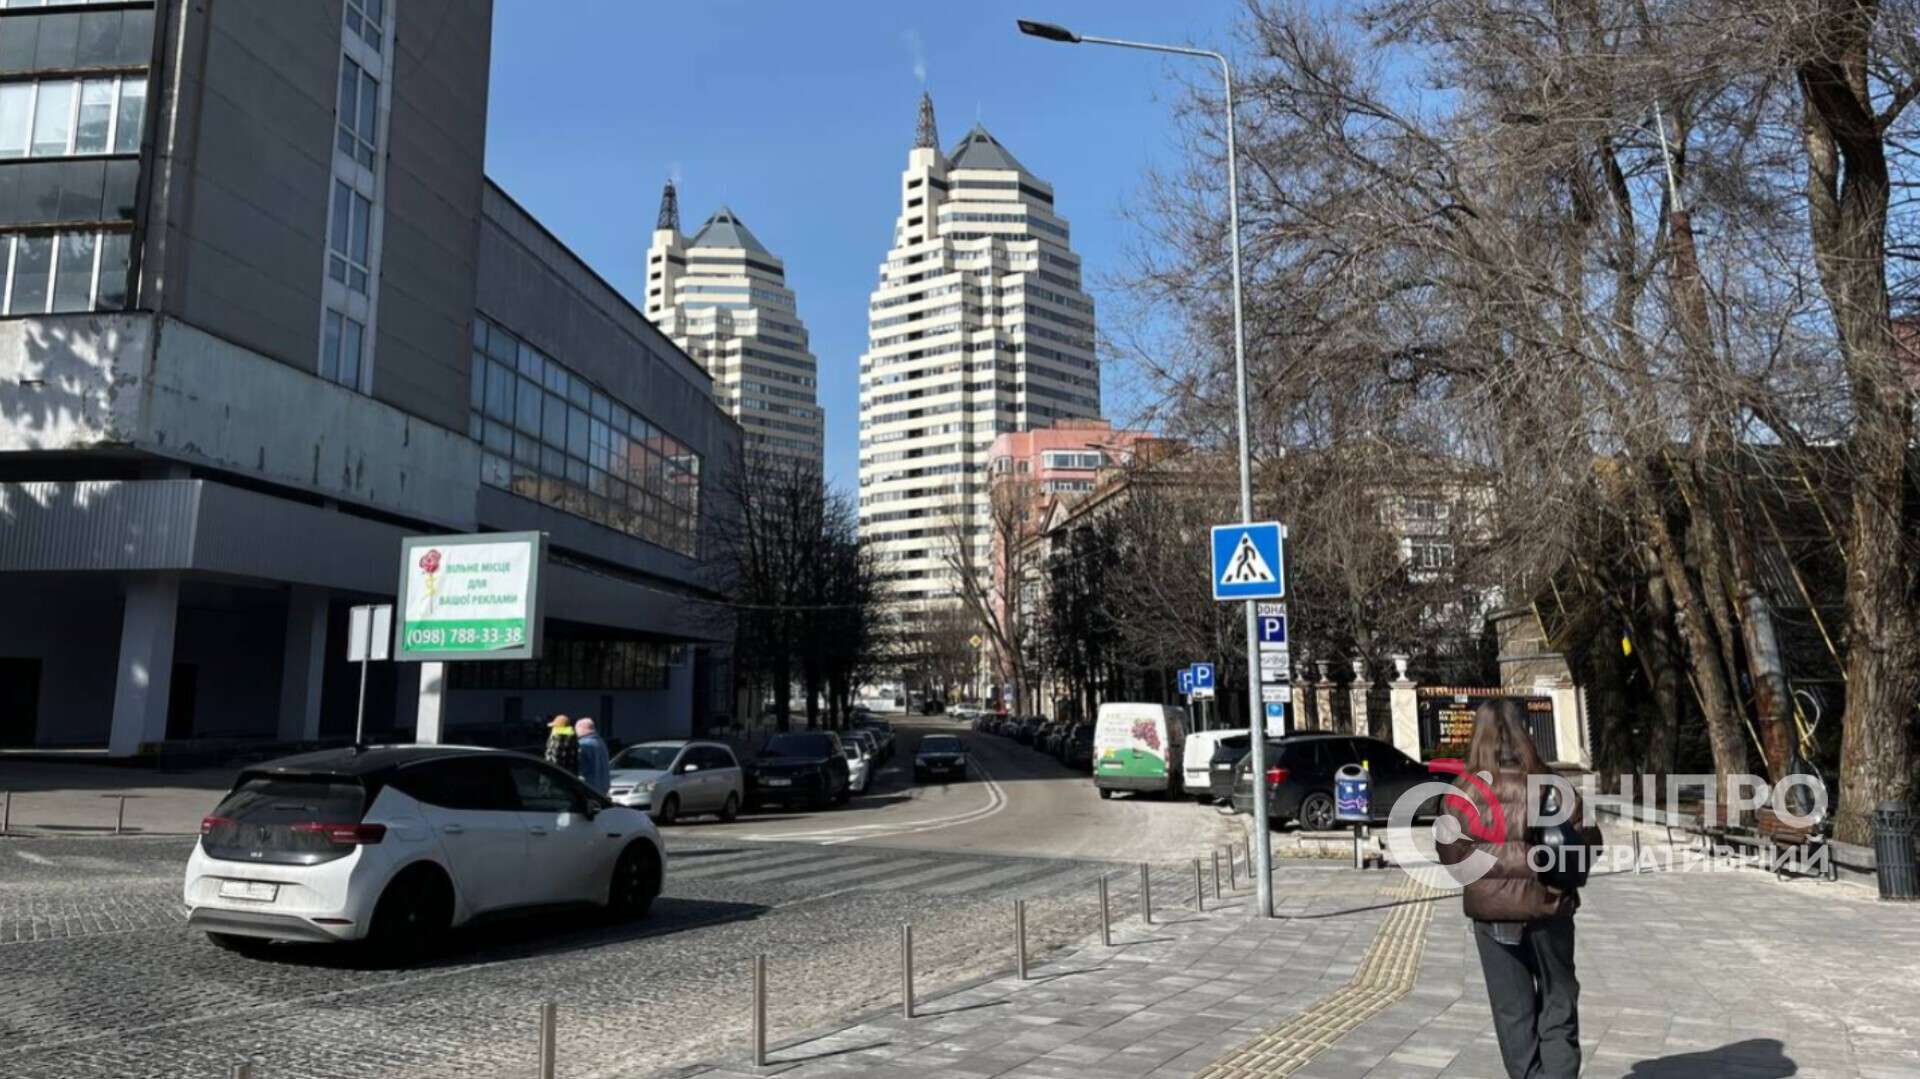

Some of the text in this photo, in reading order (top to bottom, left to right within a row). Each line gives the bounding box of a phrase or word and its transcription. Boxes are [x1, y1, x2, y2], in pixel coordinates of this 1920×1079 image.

[446, 562, 510, 574] ВІЛЬНЕ МІСЦЕ
[467, 579, 487, 589] ДЛЯ
[439, 593, 518, 605] ВАШОЇ РЕКЛАМИ
[407, 627, 522, 646] (098) 788-33-38
